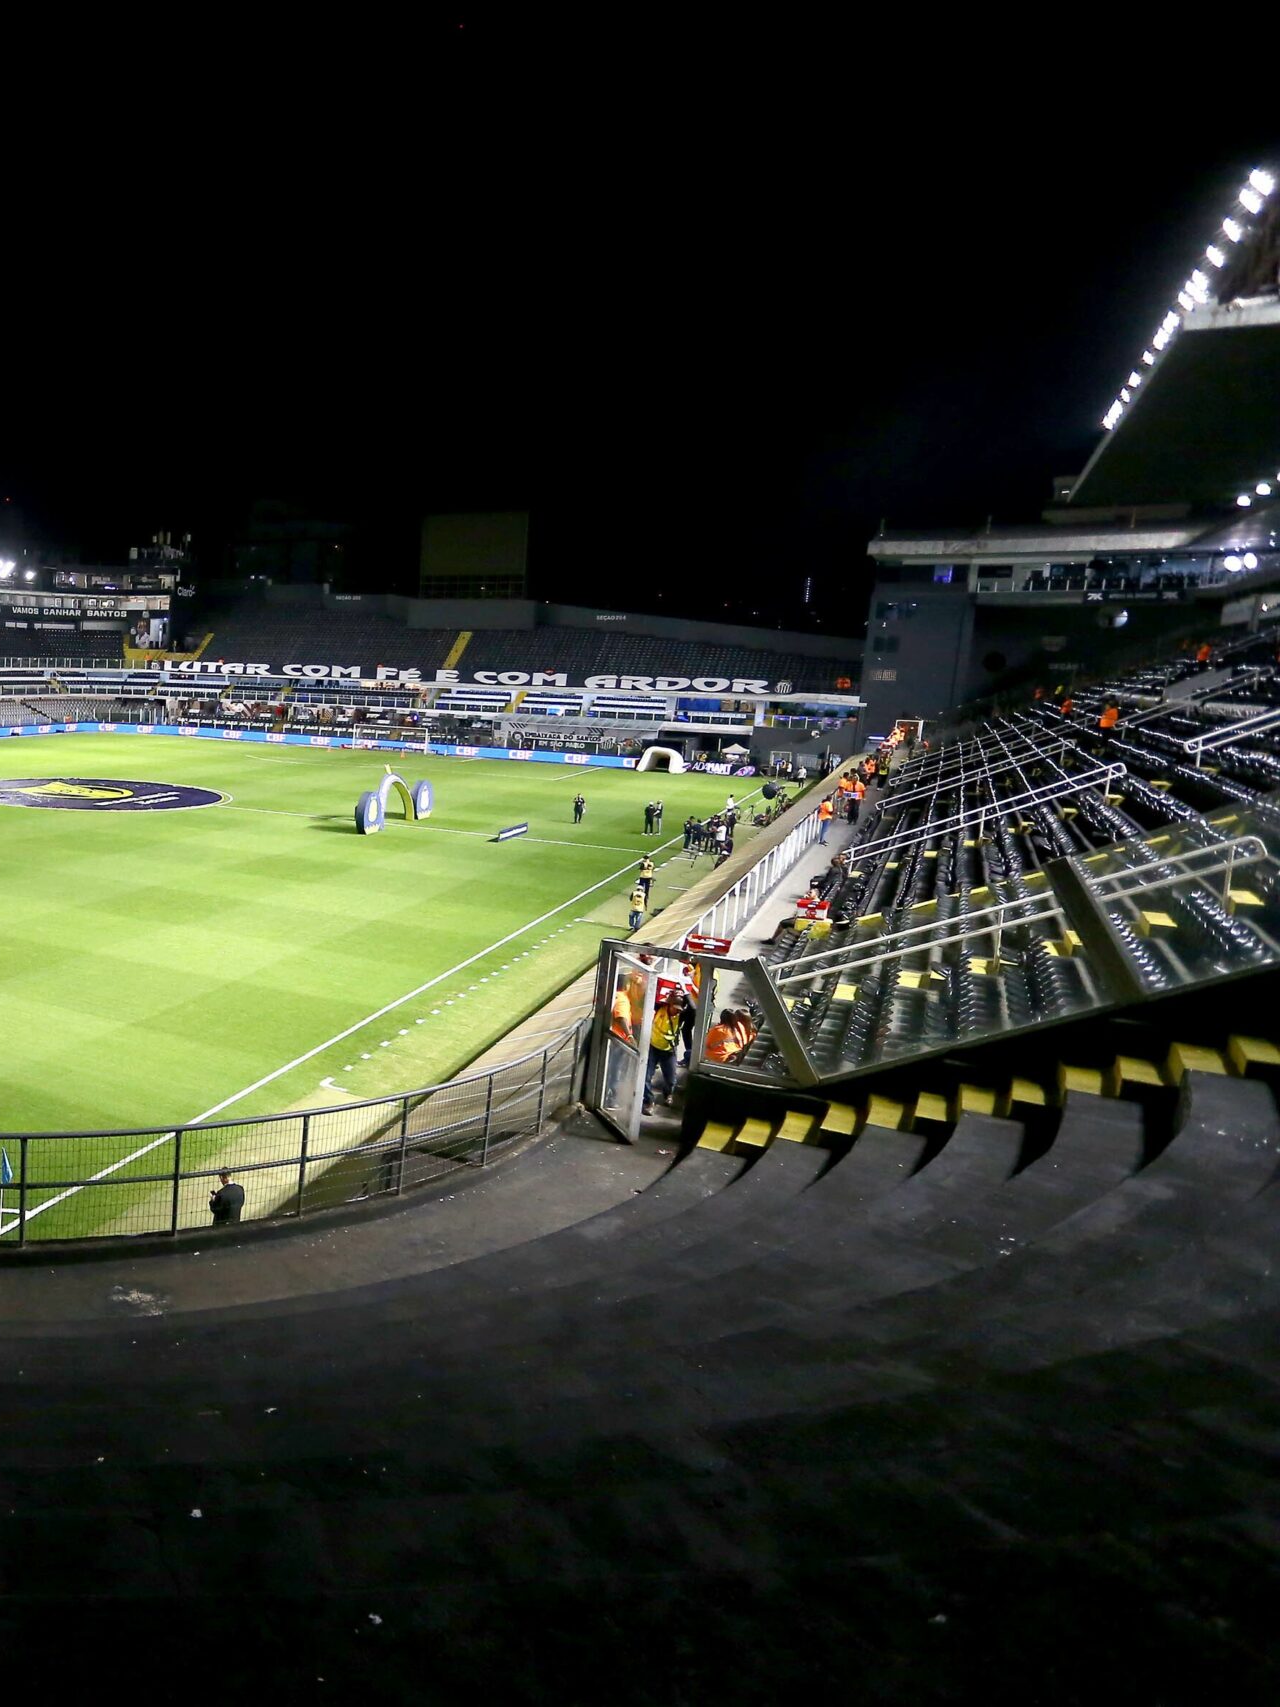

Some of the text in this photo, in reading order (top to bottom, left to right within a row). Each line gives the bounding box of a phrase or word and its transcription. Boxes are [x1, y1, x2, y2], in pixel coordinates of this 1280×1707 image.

[12, 606, 127, 618] VAMOS GANHAR SANTOS
[164, 660, 770, 694] LUTAR COM FÉ E COM ARDOR
[10, 726, 23, 734] CBF
[99, 724, 117, 732] CBF
[137, 725, 154, 733] CBF
[179, 726, 197, 735] CBF
[223, 729, 242, 739] CBF
[266, 733, 285, 743] CBF
[310, 736, 330, 746] CBF
[509, 750, 532, 759] CBF
[565, 754, 590, 763] CBF
